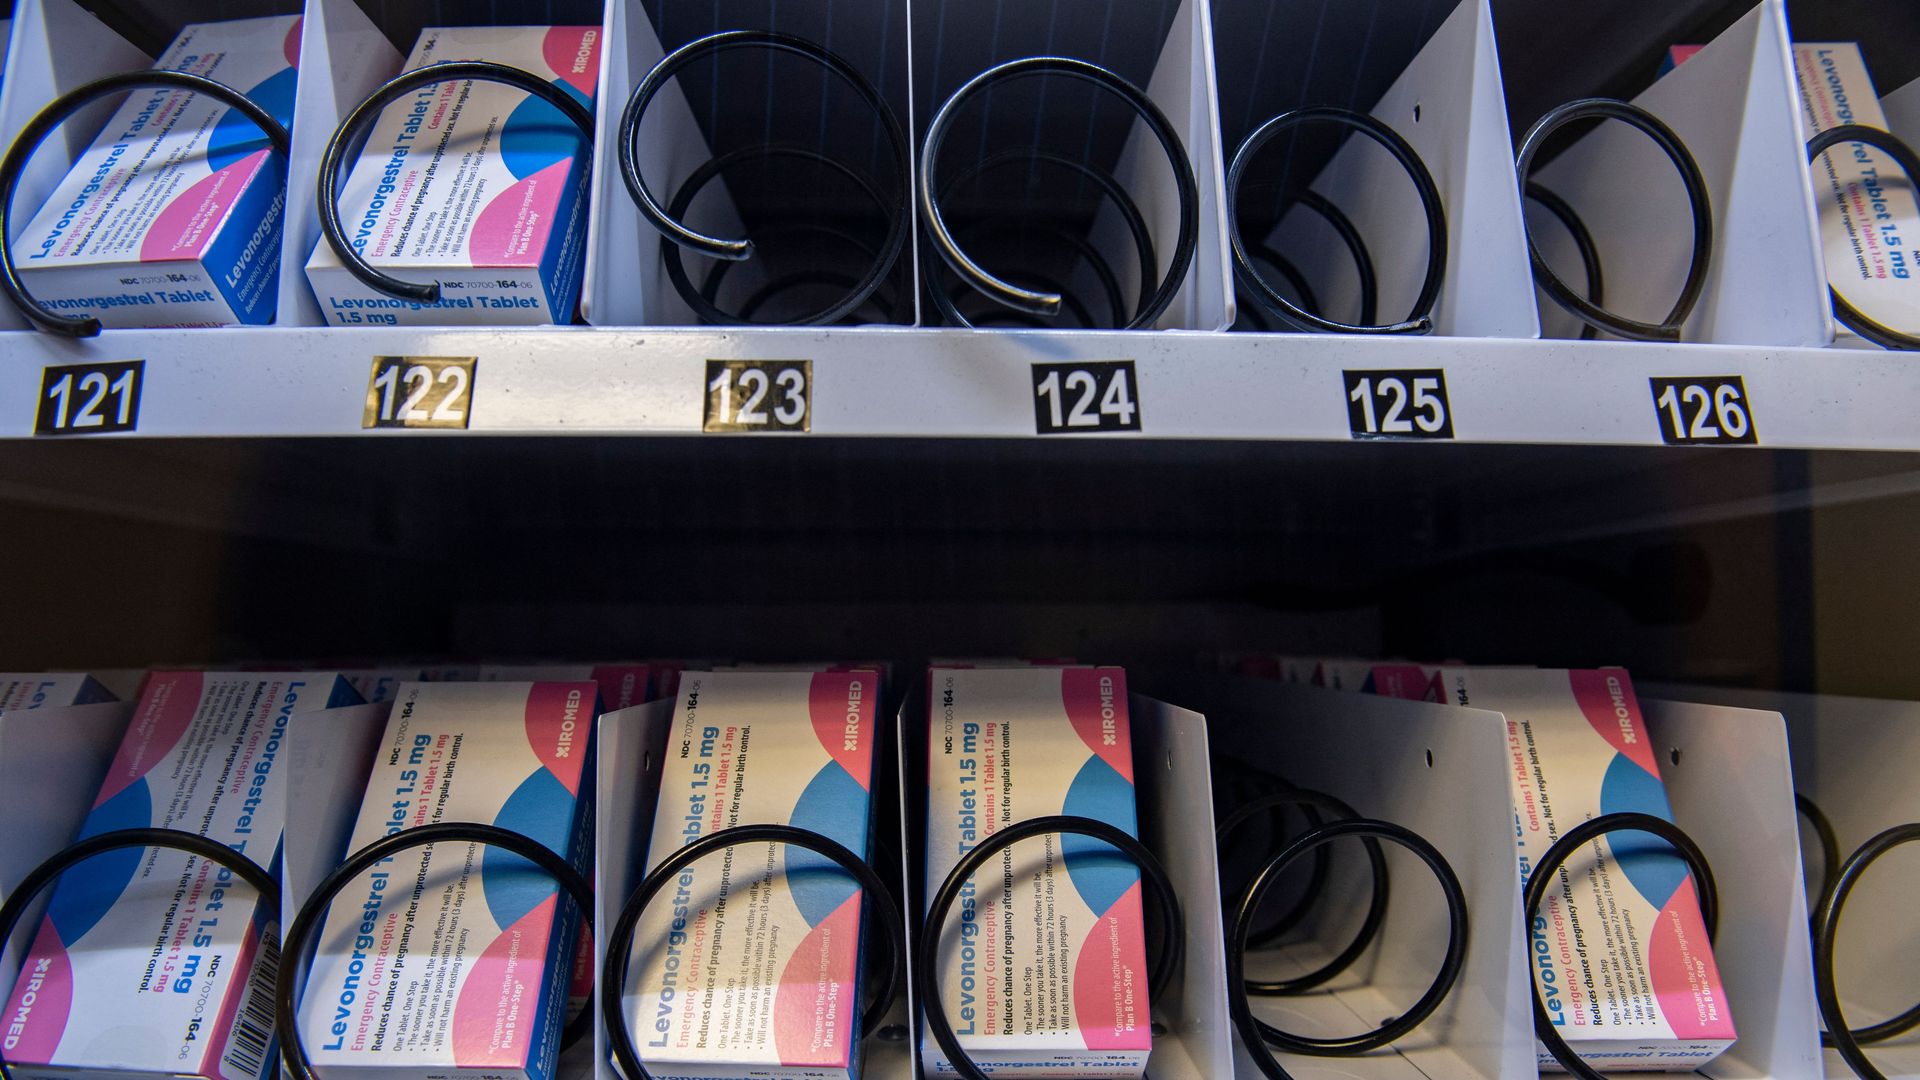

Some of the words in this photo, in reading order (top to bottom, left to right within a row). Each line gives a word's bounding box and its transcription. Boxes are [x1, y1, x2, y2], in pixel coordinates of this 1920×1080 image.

[396, 100, 430, 141] Tablet
[28, 143, 128, 257] Levonorgestrel
[118, 98, 164, 140] Tablet
[1861, 168, 1892, 220] Tablet
[370, 217, 400, 256] Emergency
[387, 170, 417, 215] Contraceptive
[390, 232, 409, 256] Reduces
[402, 212, 417, 231] chance
[413, 176, 435, 203] pregnancy
[1881, 224, 1902, 246] 1.5
[1890, 250, 1910, 278] mg
[466, 280, 533, 289] 70700-164-06
[38, 292, 154, 310] evonorgestrel
[155, 290, 214, 304] Tablet
[477, 296, 539, 308] Tablet
[337, 312, 362, 323] 1.5
[366, 313, 397, 324] mg
[49, 370, 134, 428] 121
[375, 366, 467, 420] 122
[709, 369, 805, 425] 123
[1038, 369, 1135, 427] 124
[1351, 378, 1445, 432] 125
[1658, 384, 1747, 438] 126
[253, 681, 282, 728] Emergency
[392, 689, 418, 745] 70700-164-06
[682, 680, 700, 738] 70700-164-06
[943, 677, 953, 734] 70700-164-06
[434, 734, 449, 747] mg
[697, 726, 719, 757] mg
[724, 726, 737, 740] mg
[962, 722, 979, 752] mg
[985, 722, 996, 736] mg
[1506, 721, 1517, 734] mg
[1520, 720, 1534, 745] control.
[235, 681, 304, 833] Levonorgestrel
[388, 747, 400, 765] NDC
[406, 734, 431, 764] mg
[428, 750, 442, 763] 1.5
[680, 740, 690, 758] NDC
[719, 743, 732, 756] 1.5
[983, 739, 994, 752] 1.5
[1508, 737, 1521, 749] 1.5
[1527, 747, 1539, 764] birth
[231, 730, 264, 793] Contraceptive
[690, 763, 710, 788] 1.5
[714, 759, 730, 789] Tablet
[959, 758, 976, 783] 1.5
[983, 754, 994, 783] Tablet
[1511, 752, 1528, 780] Tablet
[395, 770, 418, 794] 1.5
[419, 766, 438, 795] Tablet
[1533, 765, 1546, 791] regular
[1522, 791, 1540, 830] Contains
[1539, 793, 1549, 803] for
[1541, 805, 1552, 817] Not
[958, 789, 976, 854] Tablet
[983, 794, 994, 835] Contains
[184, 855, 198, 871] sex.
[173, 888, 186, 901] for
[178, 873, 192, 887] Not
[188, 859, 215, 904] Contains
[1002, 889, 1011, 909] after
[160, 903, 178, 934] regular
[191, 917, 218, 948] 1.5
[1003, 911, 1014, 953] pregnancy
[1059, 915, 1069, 947] pregnancy
[1547, 895, 1571, 964] Contraceptive
[151, 936, 168, 957] birth
[170, 916, 194, 951] Tablet
[685, 909, 707, 982] Contraceptive
[983, 900, 996, 972] Contraceptive
[163, 954, 179, 971] 1.5
[206, 954, 221, 977] NDC
[321, 872, 388, 1050] Levonorgestrel
[648, 867, 693, 1046] Levonorgestrel
[1002, 954, 1012, 964] of
[1059, 948, 1069, 973] existing
[137, 959, 156, 994] control.
[152, 974, 170, 993] mg
[171, 954, 202, 994] mg
[349, 989, 380, 1050] Emergency
[367, 913, 397, 985] Contraceptive
[1003, 966, 1012, 996] chance
[1023, 966, 1032, 980] Step
[984, 975, 998, 1034] Emergency
[1060, 984, 1069, 1002] harm
[1565, 967, 1586, 1025] Emergency
[176, 979, 214, 1060] 70700-164-06
[232, 1008, 244, 1037] 16406
[676, 986, 699, 1047] Emergency
[1003, 998, 1013, 1034] Reduces
[1024, 997, 1032, 1019] Tablet.
[1061, 1016, 1070, 1029] Will
[1062, 1003, 1070, 1014] not
[501, 1029, 514, 1048] Plan
[823, 1028, 834, 1047] Plan
